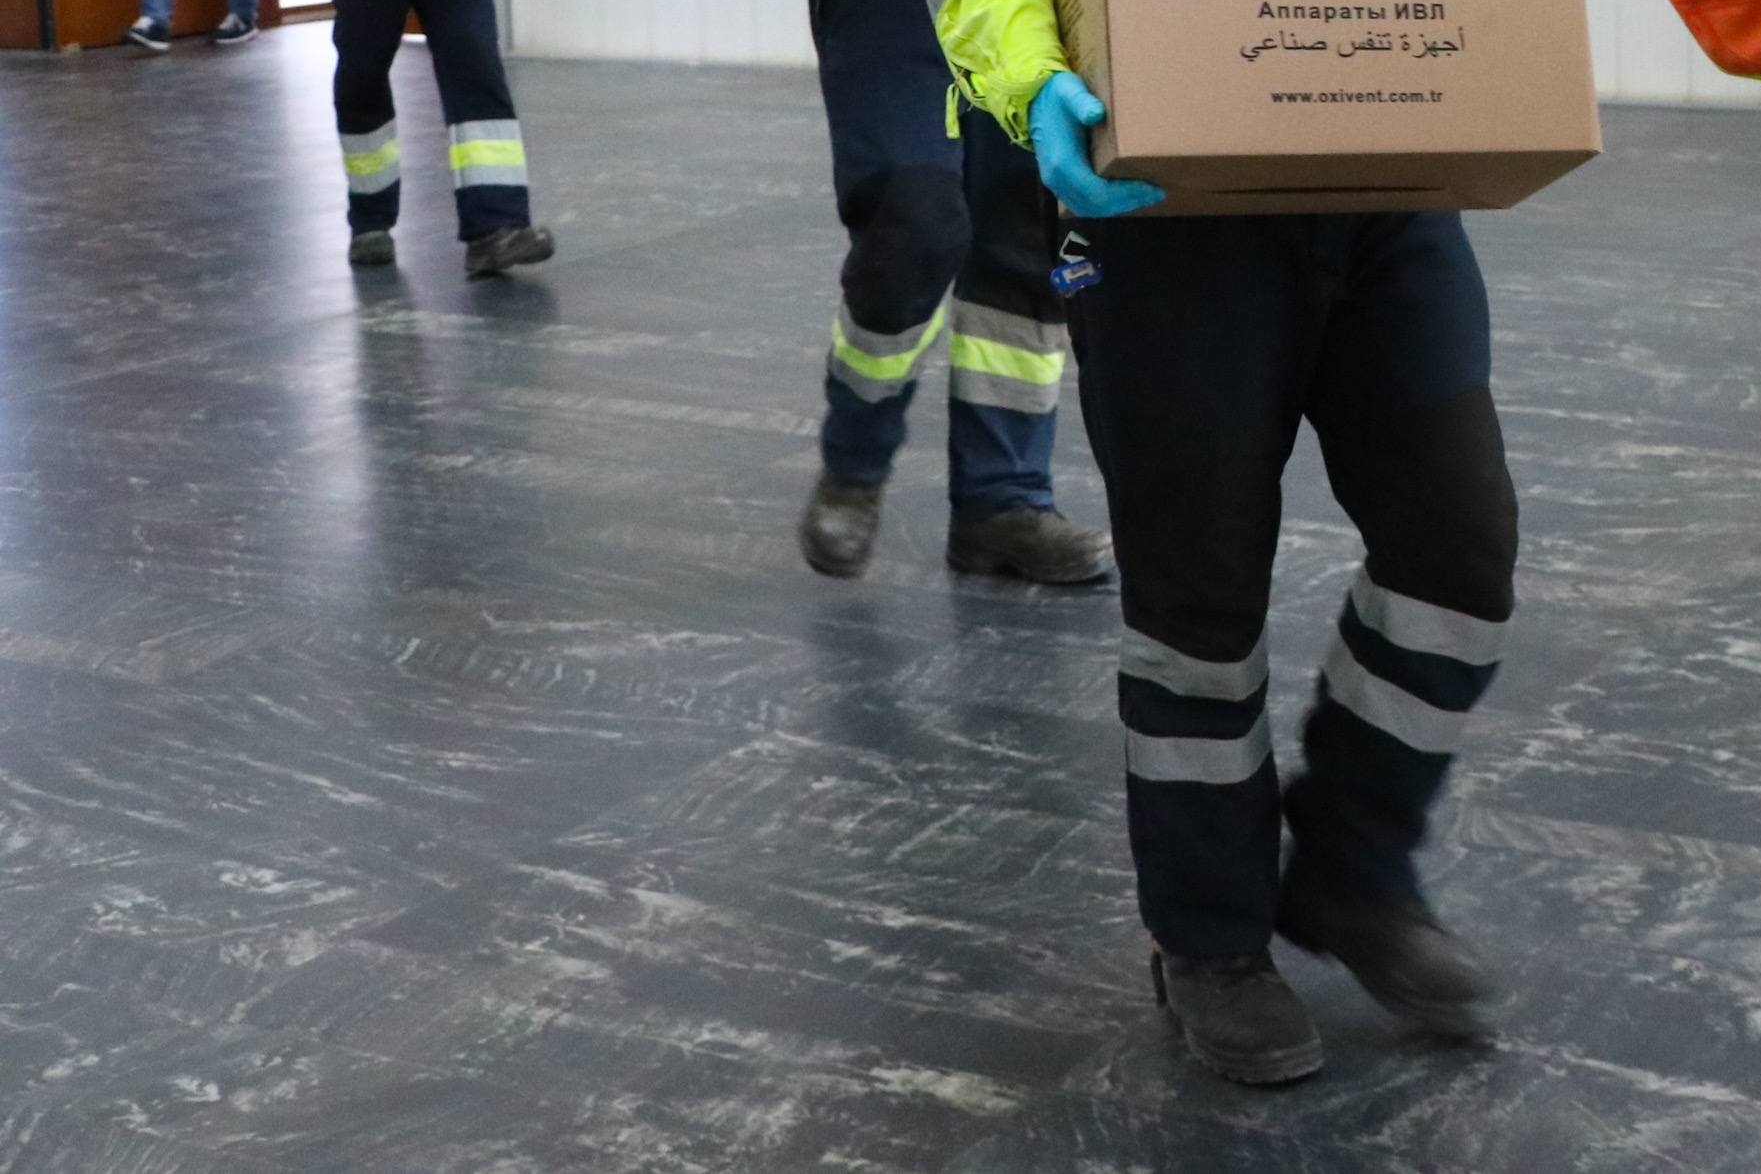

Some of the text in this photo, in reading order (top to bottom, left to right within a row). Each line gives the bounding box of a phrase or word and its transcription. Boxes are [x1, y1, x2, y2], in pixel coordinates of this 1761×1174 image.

[1258, 1, 1445, 23] Аппараты ИВЛ
[1239, 25, 1466, 63] أجهزة تنفس صناعي
[1271, 90, 1443, 104] www.oxivent.com.tr
